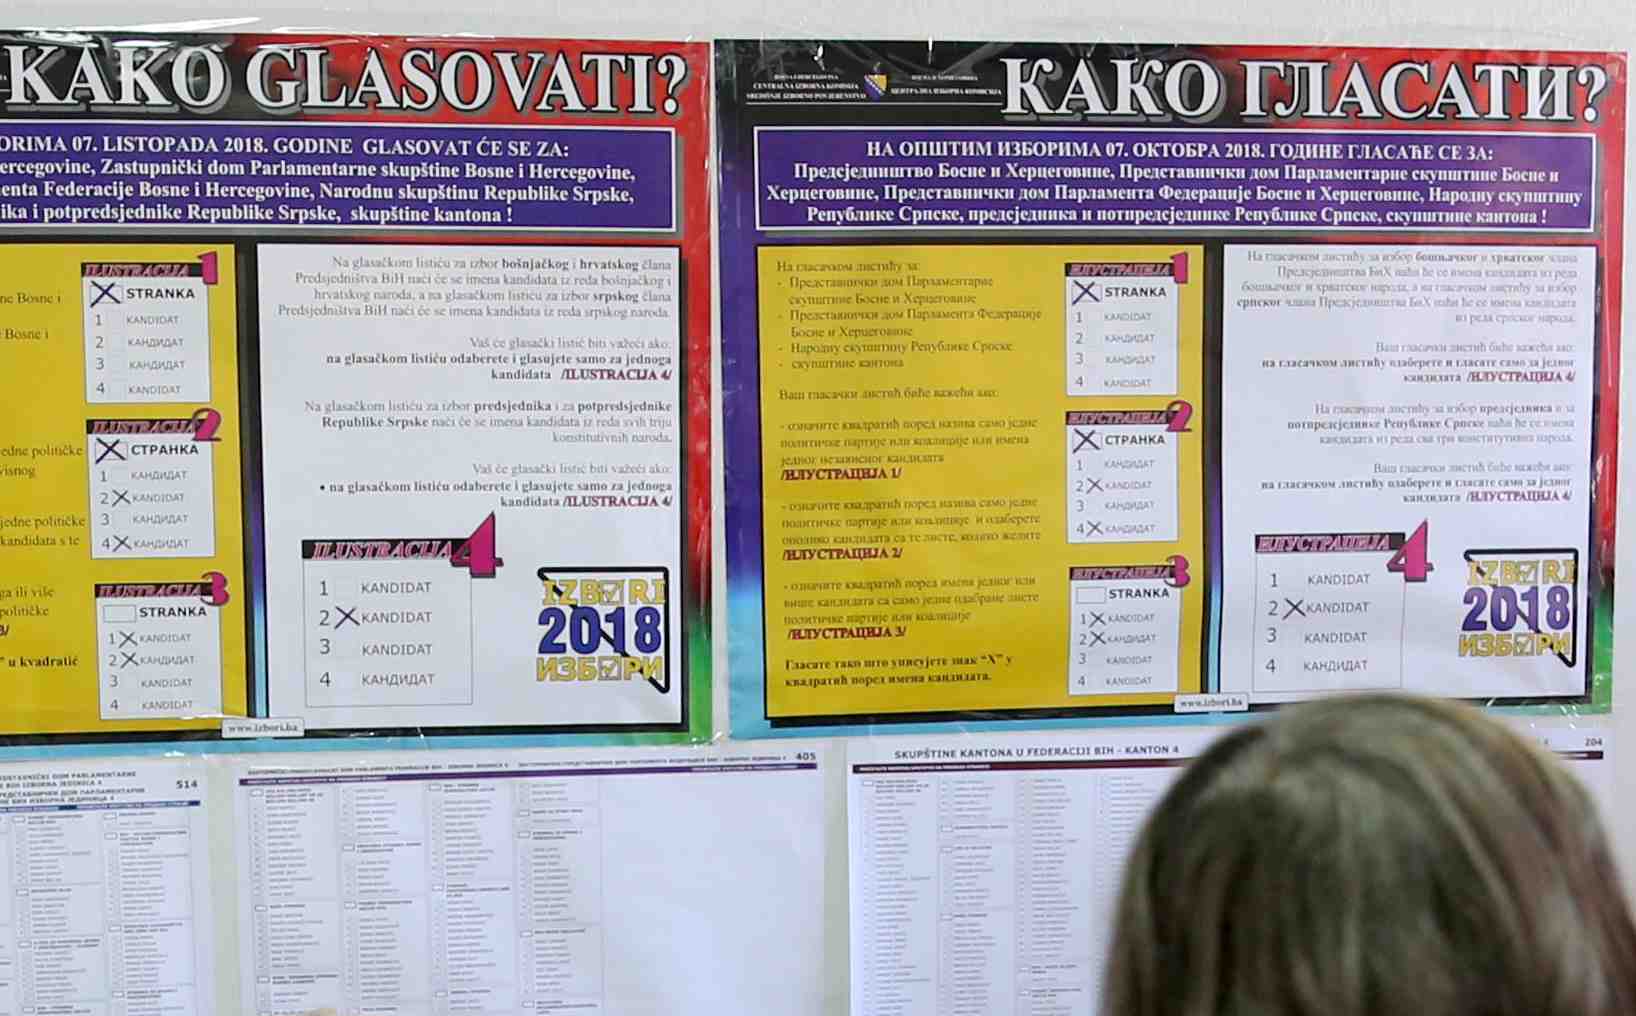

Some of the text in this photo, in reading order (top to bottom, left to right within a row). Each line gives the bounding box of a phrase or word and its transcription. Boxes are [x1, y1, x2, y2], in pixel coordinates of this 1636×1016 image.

[3, 45, 687, 114] KAKO GLASOVATI?
[1000, 56, 1607, 122] КАКО ГЛАСАТИ?
[72, 135, 97, 151] 07.
[103, 136, 219, 152] LISTOPADA
[223, 137, 268, 153] 2018.
[273, 137, 352, 154] GODINE
[362, 139, 471, 155] GLASOVAT
[476, 137, 503, 156] ĆE
[507, 140, 531, 156] SE
[536, 141, 568, 157] ZA:
[867, 141, 1493, 160] НА ОПШТИМ ИЗБОРИМА 07. ОКТОБРА 2018. ГОДИНЕ ГЛАСАЋЕ СЕ ЗА:
[100, 158, 202, 177] Zastupnički
[207, 159, 244, 175] dom
[250, 160, 376, 176] Parlamentarne
[380, 162, 459, 180] skupštine
[464, 162, 514, 178] Bosne
[518, 163, 524, 178] i
[529, 163, 635, 182] Hercegovine,
[794, 162, 1558, 183] Предсједништво Босне и Херцеговине, Представнички дом Парламентарне скупштине Босне и
[0, 180, 633, 205] enta Federacije Bosne i Hercegovine, Narodnu skupštinu Republike Srpske,
[767, 184, 1582, 206] Херцеговине, Представнички дом Парламента Федерације Босне и Херцеговине, Народну скупштину
[32, 203, 38, 219] i
[43, 203, 182, 221] potpredsjednike
[187, 204, 274, 221] Republike
[278, 204, 341, 222] Srpske,
[350, 206, 429, 222] skupštine
[433, 207, 501, 222] kantona
[807, 206, 894, 224] Републике
[898, 206, 964, 224] Српске,
[968, 208, 1077, 224] предсједника
[1082, 209, 1092, 221] и
[1096, 208, 1230, 223] потпредсједнике
[1235, 206, 1317, 224] Републике
[1320, 207, 1382, 225] Српске,
[1385, 211, 1472, 224] скупштине
[1476, 212, 1537, 223] кантона
[127, 288, 195, 300] STRANKA
[1105, 287, 1167, 297] STRANKA
[491, 369, 551, 379] kandidata
[474, 400, 670, 413] predsjednika potpredsjednike
[322, 416, 428, 429] Republike Srpske
[1105, 434, 1166, 445] СТРАНКА
[131, 444, 199, 456] СТРАНКА
[312, 511, 504, 578] ILUSTRACIJA 4
[1258, 518, 1434, 582] ИЛУСТРАЦИЈА 4
[1270, 573, 1371, 587] 1 KANDIDAT
[319, 581, 432, 596] 1 KANDIDAT
[1109, 588, 1170, 600] STRANKA
[139, 606, 207, 618] STRANKA
[1268, 601, 1371, 616] 2 KANDIDAT
[1462, 585, 1570, 632] 2018
[319, 611, 432, 626] 2 KANDIDAT
[538, 606, 662, 655] 2018
[1266, 627, 1368, 644] 3 KANDIDAT
[319, 639, 433, 656] 3 KANDIDAT
[1265, 658, 1368, 673] 4 КАНДИДАТ
[320, 672, 435, 687] 4 КАНДИДАТ
[894, 749, 955, 758] SKUPŠTINE
[960, 748, 1012, 757] KANTONA
[1016, 748, 1023, 757] U
[1027, 747, 1090, 756] FEDERACIJI
[1094, 746, 1113, 755] BIH
[1125, 745, 1168, 754] KANTON
[176, 780, 198, 789] 514
